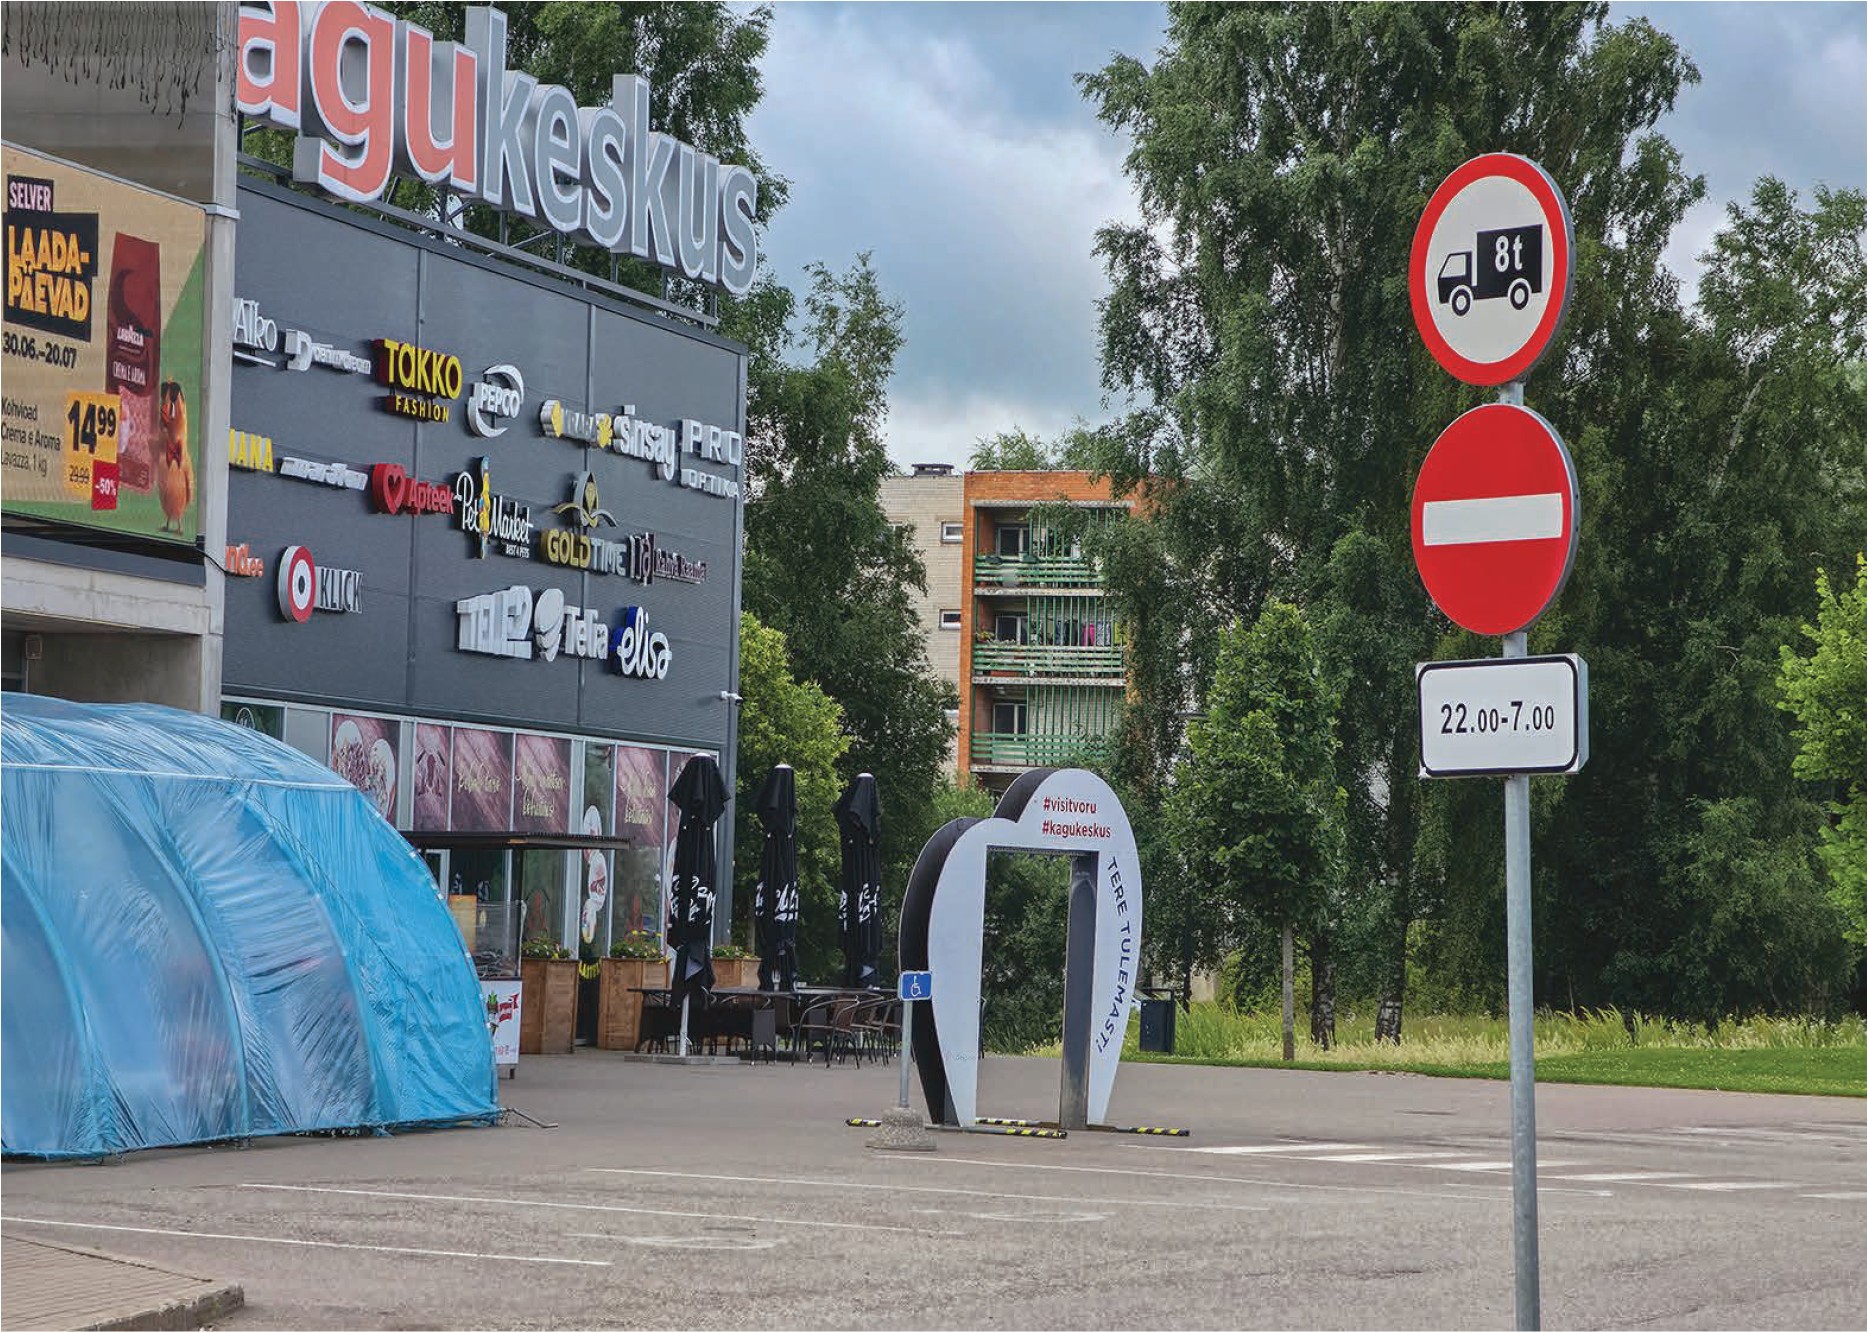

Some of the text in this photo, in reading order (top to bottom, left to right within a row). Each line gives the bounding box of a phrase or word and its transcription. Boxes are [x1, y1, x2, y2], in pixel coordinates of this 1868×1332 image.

[9, 181, 51, 211] SELVER
[8, 225, 90, 275] LAADA-
[1494, 233, 1523, 272] 8t
[8, 260, 90, 322] PÄEVAD
[395, 395, 450, 423] FASHION
[473, 381, 522, 419] PEPCO
[1, 421, 27, 444] Crema
[35, 429, 61, 452] Aroma
[683, 418, 743, 466] PRO
[95, 477, 117, 497] -50%
[406, 477, 455, 515] Apteek
[682, 468, 741, 500] OPTIKA
[454, 471, 534, 544] Pet Market
[317, 566, 365, 615] KLICK
[563, 604, 609, 660] Telia
[616, 605, 674, 681] elisa
[1441, 701, 1555, 734] 22.00-7.00
[1042, 796, 1098, 815] #visitvoru
[1041, 819, 1112, 839] #kagukeskus
[1095, 855, 1132, 1054] TERE TULEMAST!
